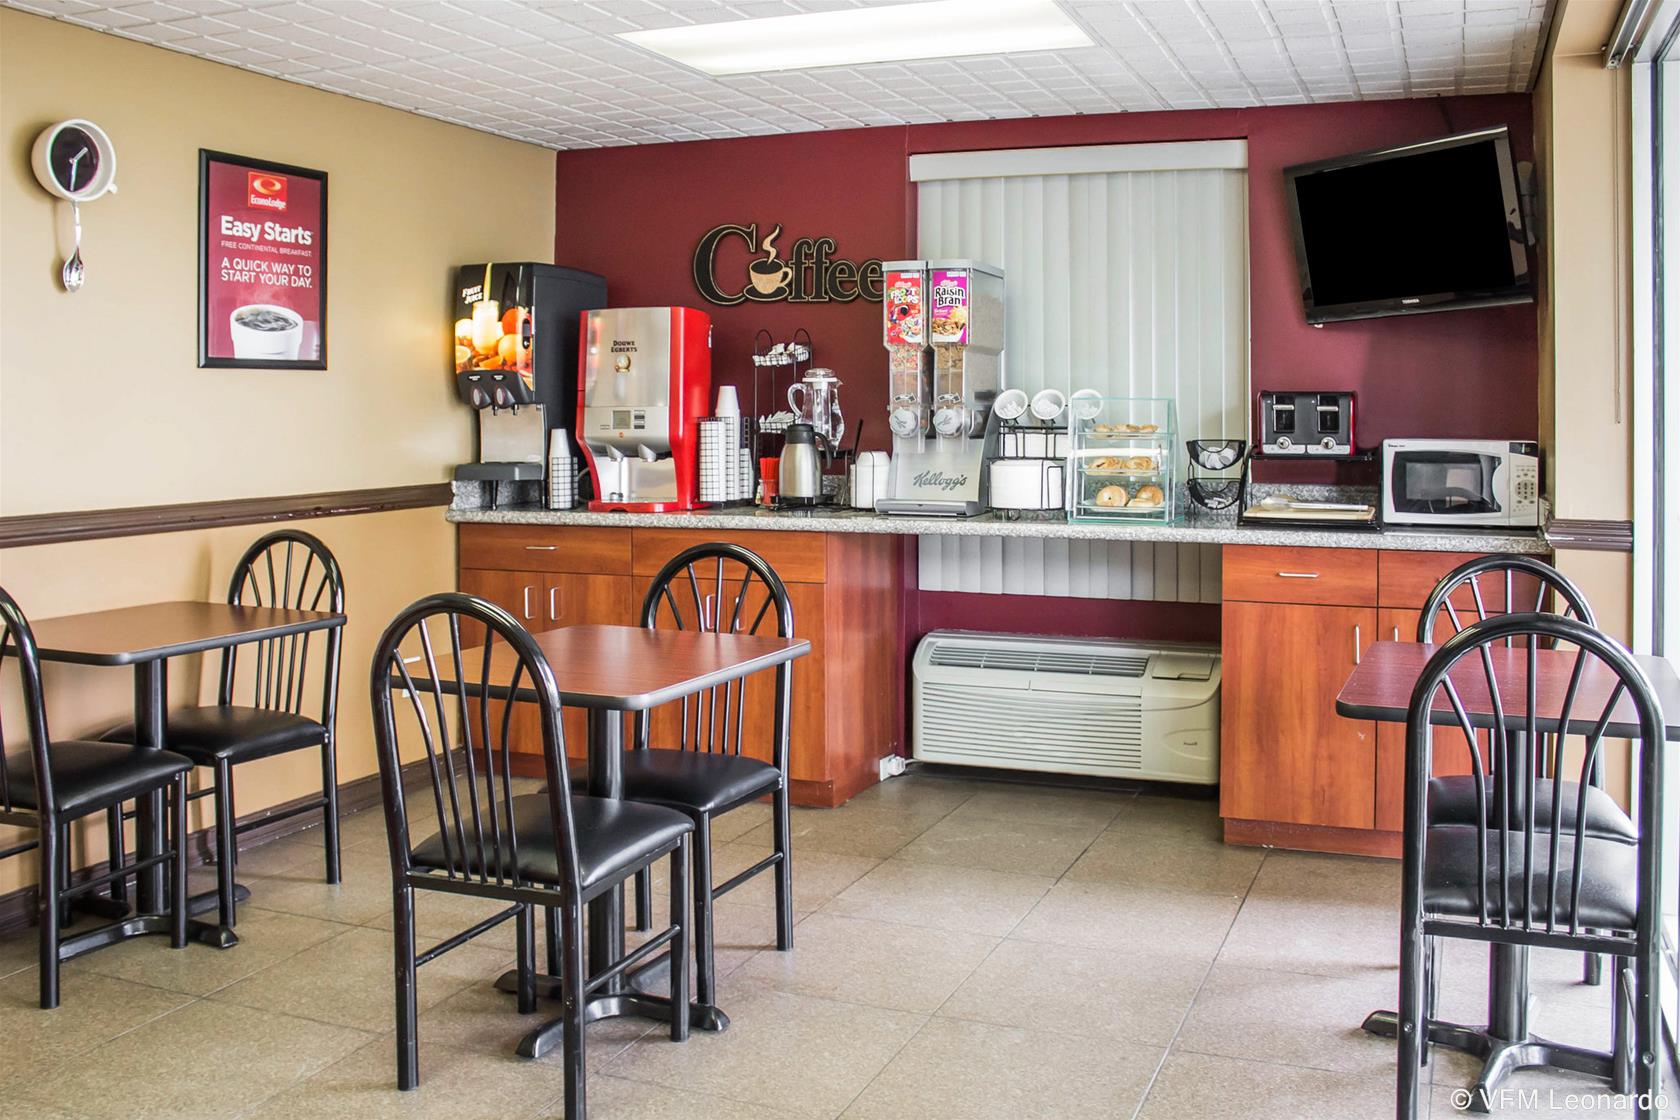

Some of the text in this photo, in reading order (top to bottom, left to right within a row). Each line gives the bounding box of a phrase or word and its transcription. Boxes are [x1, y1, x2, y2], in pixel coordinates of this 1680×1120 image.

[221, 215, 312, 245] Easy Starts
[221, 240, 237, 249] FREE
[238, 242, 278, 254] CONTINENTAL
[221, 257, 312, 277] A QUICK WAY TO
[221, 269, 313, 289] START YOUR DAY.
[935, 287, 964, 298] Raisin
[938, 296, 961, 306] Bran
[912, 470, 968, 491] Kellogg's
